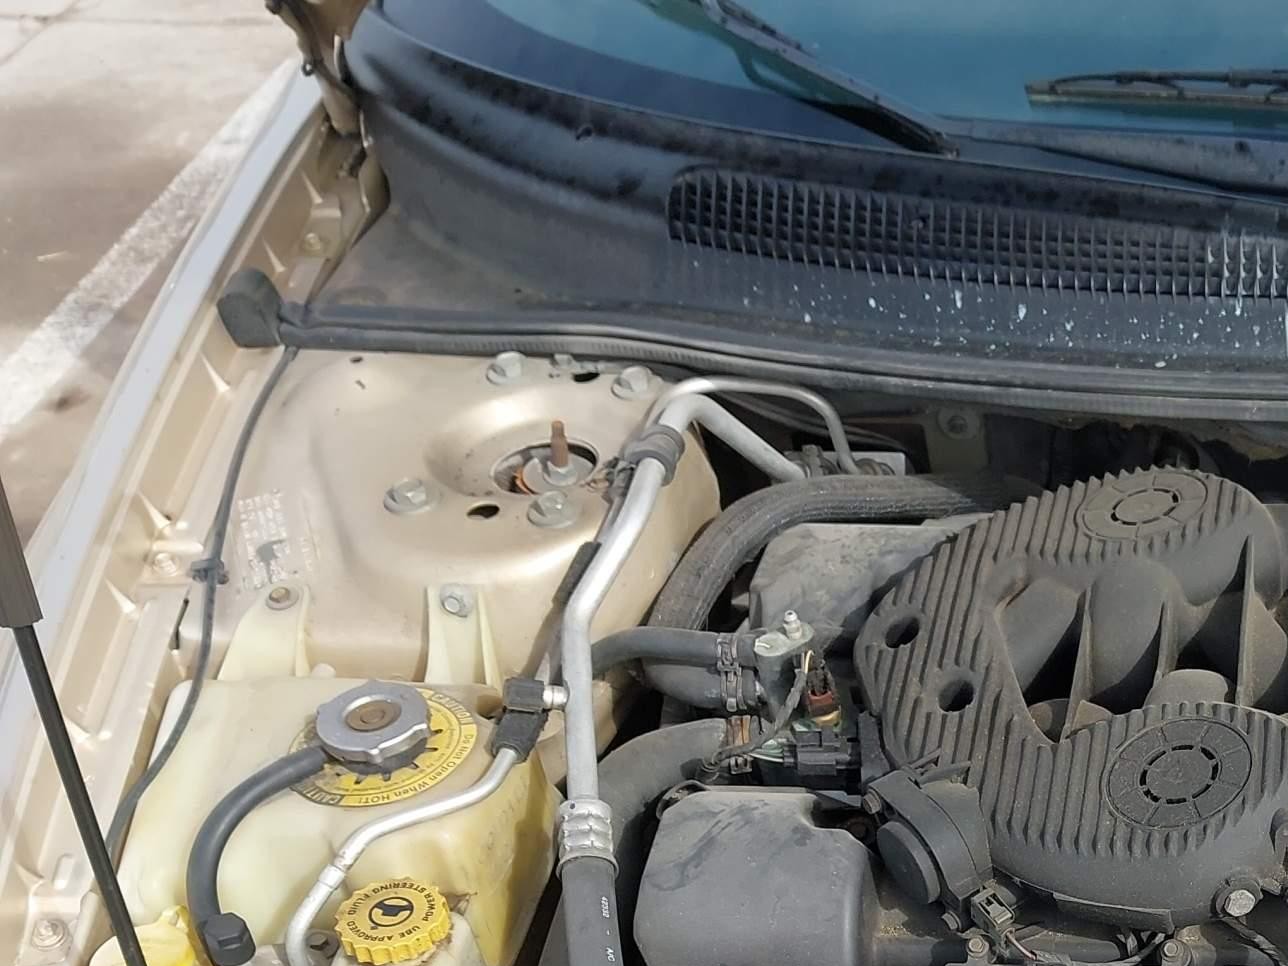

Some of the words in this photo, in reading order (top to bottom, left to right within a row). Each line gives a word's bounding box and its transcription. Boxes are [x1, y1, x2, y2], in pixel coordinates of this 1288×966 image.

[430, 761, 456, 781] Open
[394, 780, 428, 798] When
[372, 882, 426, 894] STEERING
[348, 893, 371, 916] FLUID
[422, 892, 436, 922] POWER
[346, 920, 394, 942] APPROVED
